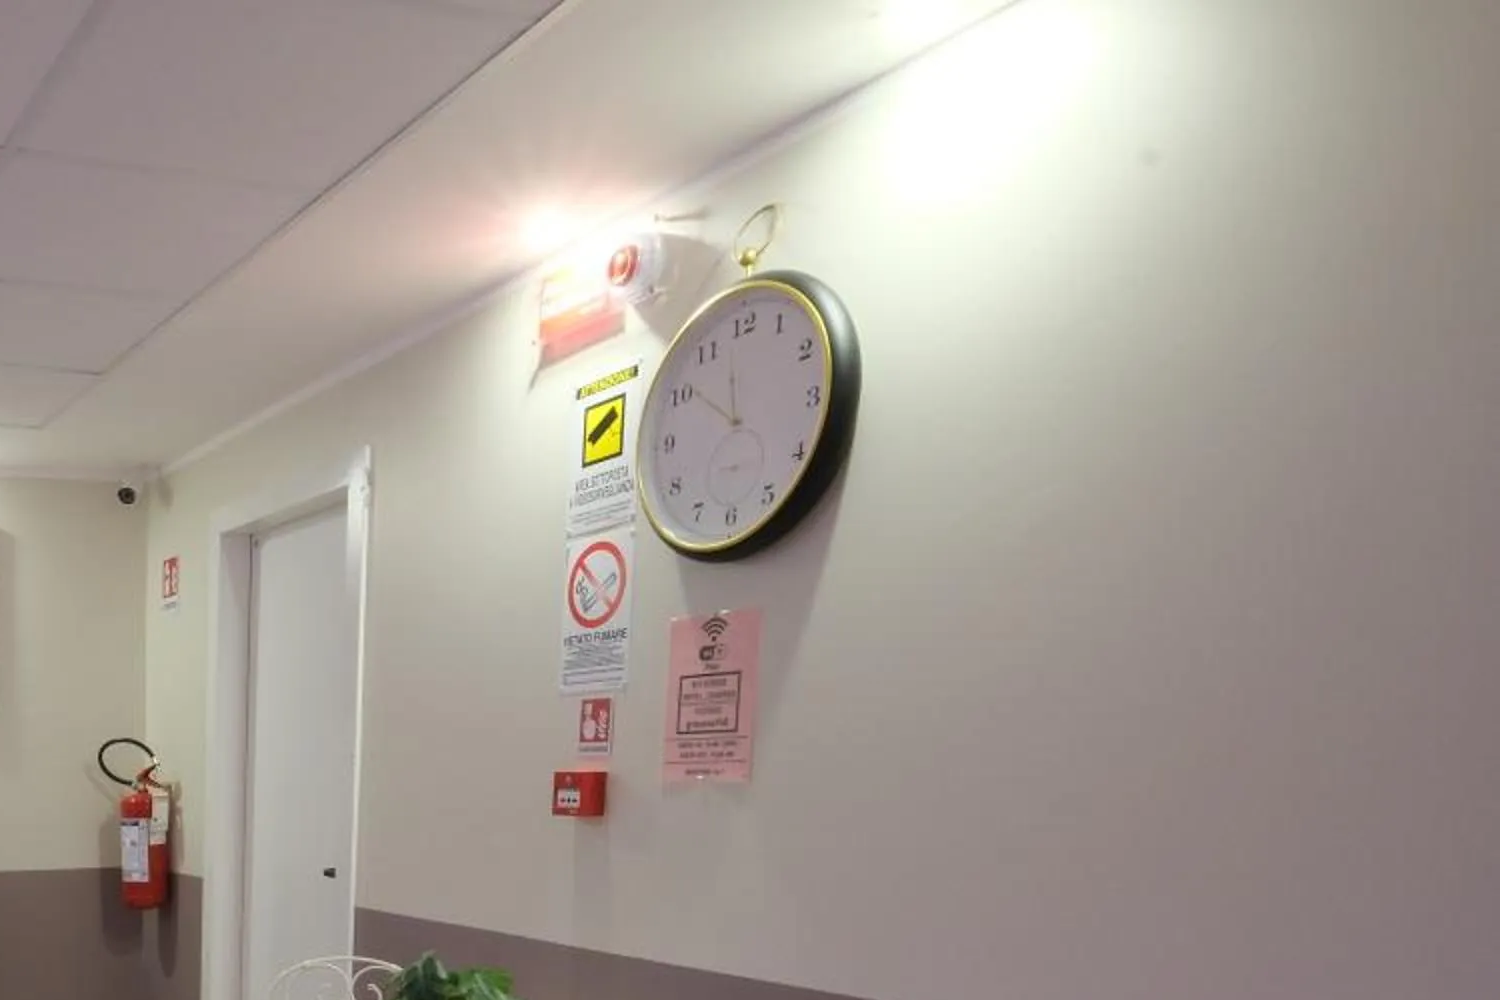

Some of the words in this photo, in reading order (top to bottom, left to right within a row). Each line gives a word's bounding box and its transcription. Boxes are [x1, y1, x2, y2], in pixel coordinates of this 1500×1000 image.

[732, 312, 756, 338] 12
[775, 313, 784, 335] 1
[698, 340, 718, 365] 11
[798, 338, 813, 362] 2
[671, 383, 693, 408] 10
[806, 385, 821, 408] 3
[664, 433, 675, 455] 9
[790, 440, 804, 461] 4
[669, 476, 683, 497] 8
[761, 481, 776, 506] 5
[692, 501, 705, 523] 7
[725, 506, 737, 527] 6
